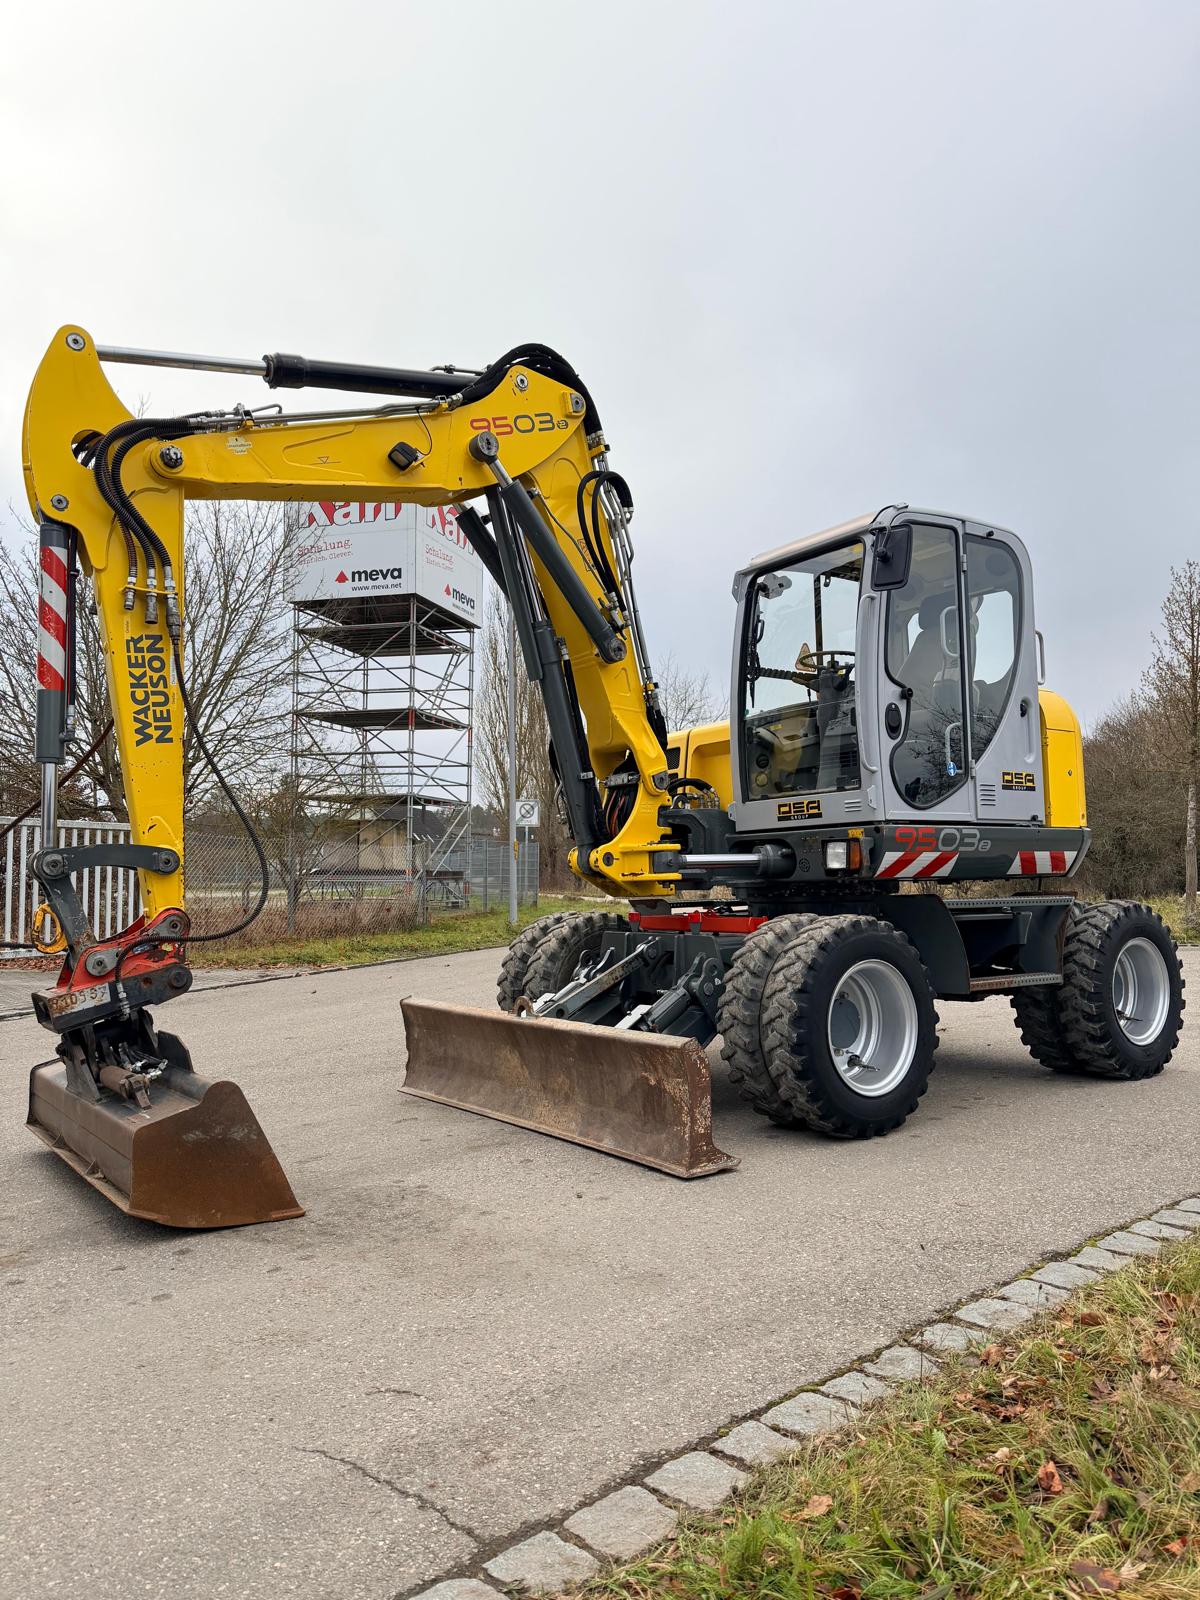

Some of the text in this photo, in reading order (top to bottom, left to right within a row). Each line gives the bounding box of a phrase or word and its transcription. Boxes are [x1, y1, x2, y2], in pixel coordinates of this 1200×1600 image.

[352, 568, 402, 582] meva
[352, 583, 402, 592] www.meva.net
[453, 588, 475, 610] meva
[126, 634, 154, 748] WACKER
[145, 633, 174, 744] NEUSON
